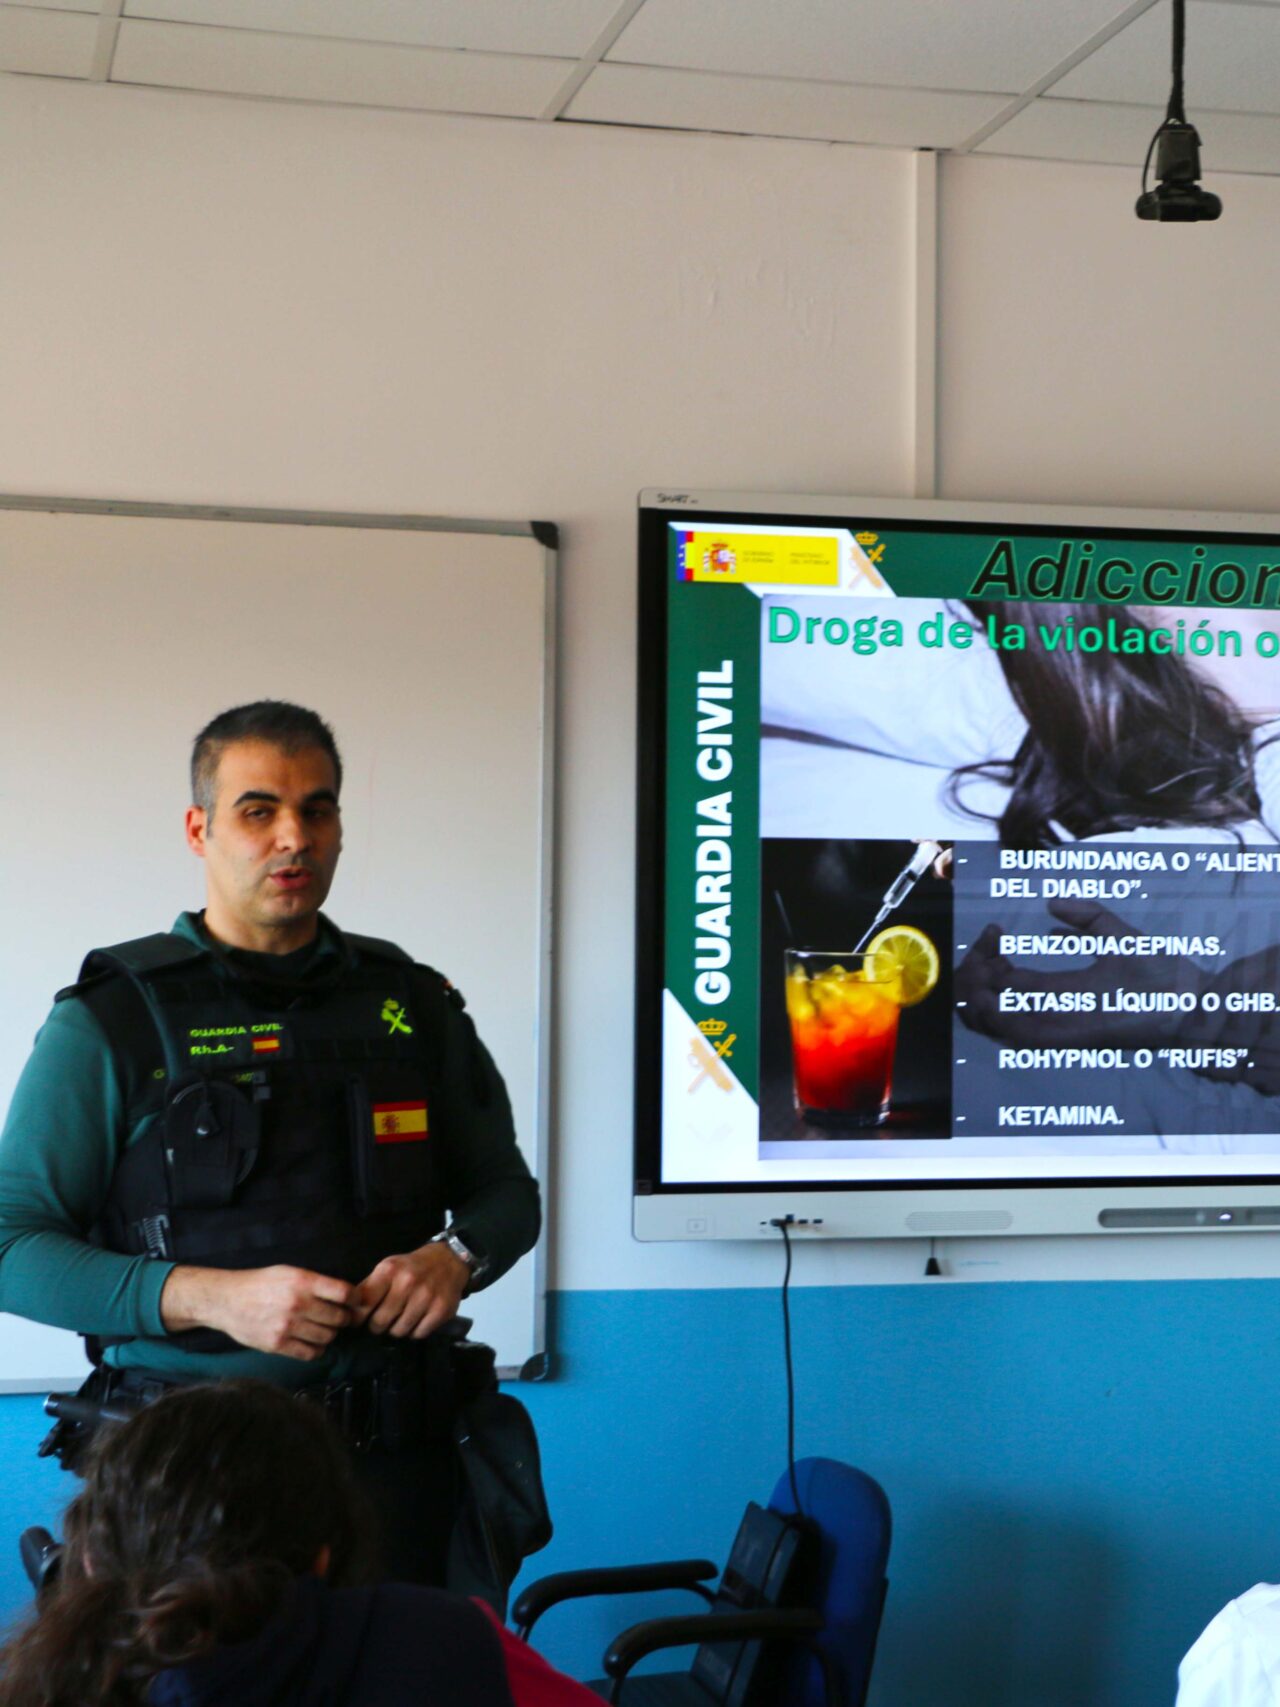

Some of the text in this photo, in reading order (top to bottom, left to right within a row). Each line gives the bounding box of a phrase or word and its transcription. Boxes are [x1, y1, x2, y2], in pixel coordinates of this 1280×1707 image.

[768, 606, 904, 655] Droga
[918, 612, 973, 648] de
[987, 614, 1026, 650] la
[1039, 616, 1243, 657] violación
[1255, 630, 1280, 658] o
[694, 659, 734, 1005] GUARDIA CIVIL
[1000, 849, 1168, 871] BURUNDANGA
[1171, 851, 1190, 871] O
[990, 878, 1037, 898] DEL
[999, 935, 1226, 956] BENZODIACEPINAS.
[999, 988, 1097, 1012] ÉXTASIS
[1102, 987, 1197, 1013] LÍQUIDO
[1201, 992, 1220, 1012] O
[190, 1026, 247, 1038] GUARDIA
[999, 1048, 1130, 1069] ROHYPNOL
[1133, 1048, 1153, 1069] O
[999, 1105, 1125, 1126] KETAMINA.
